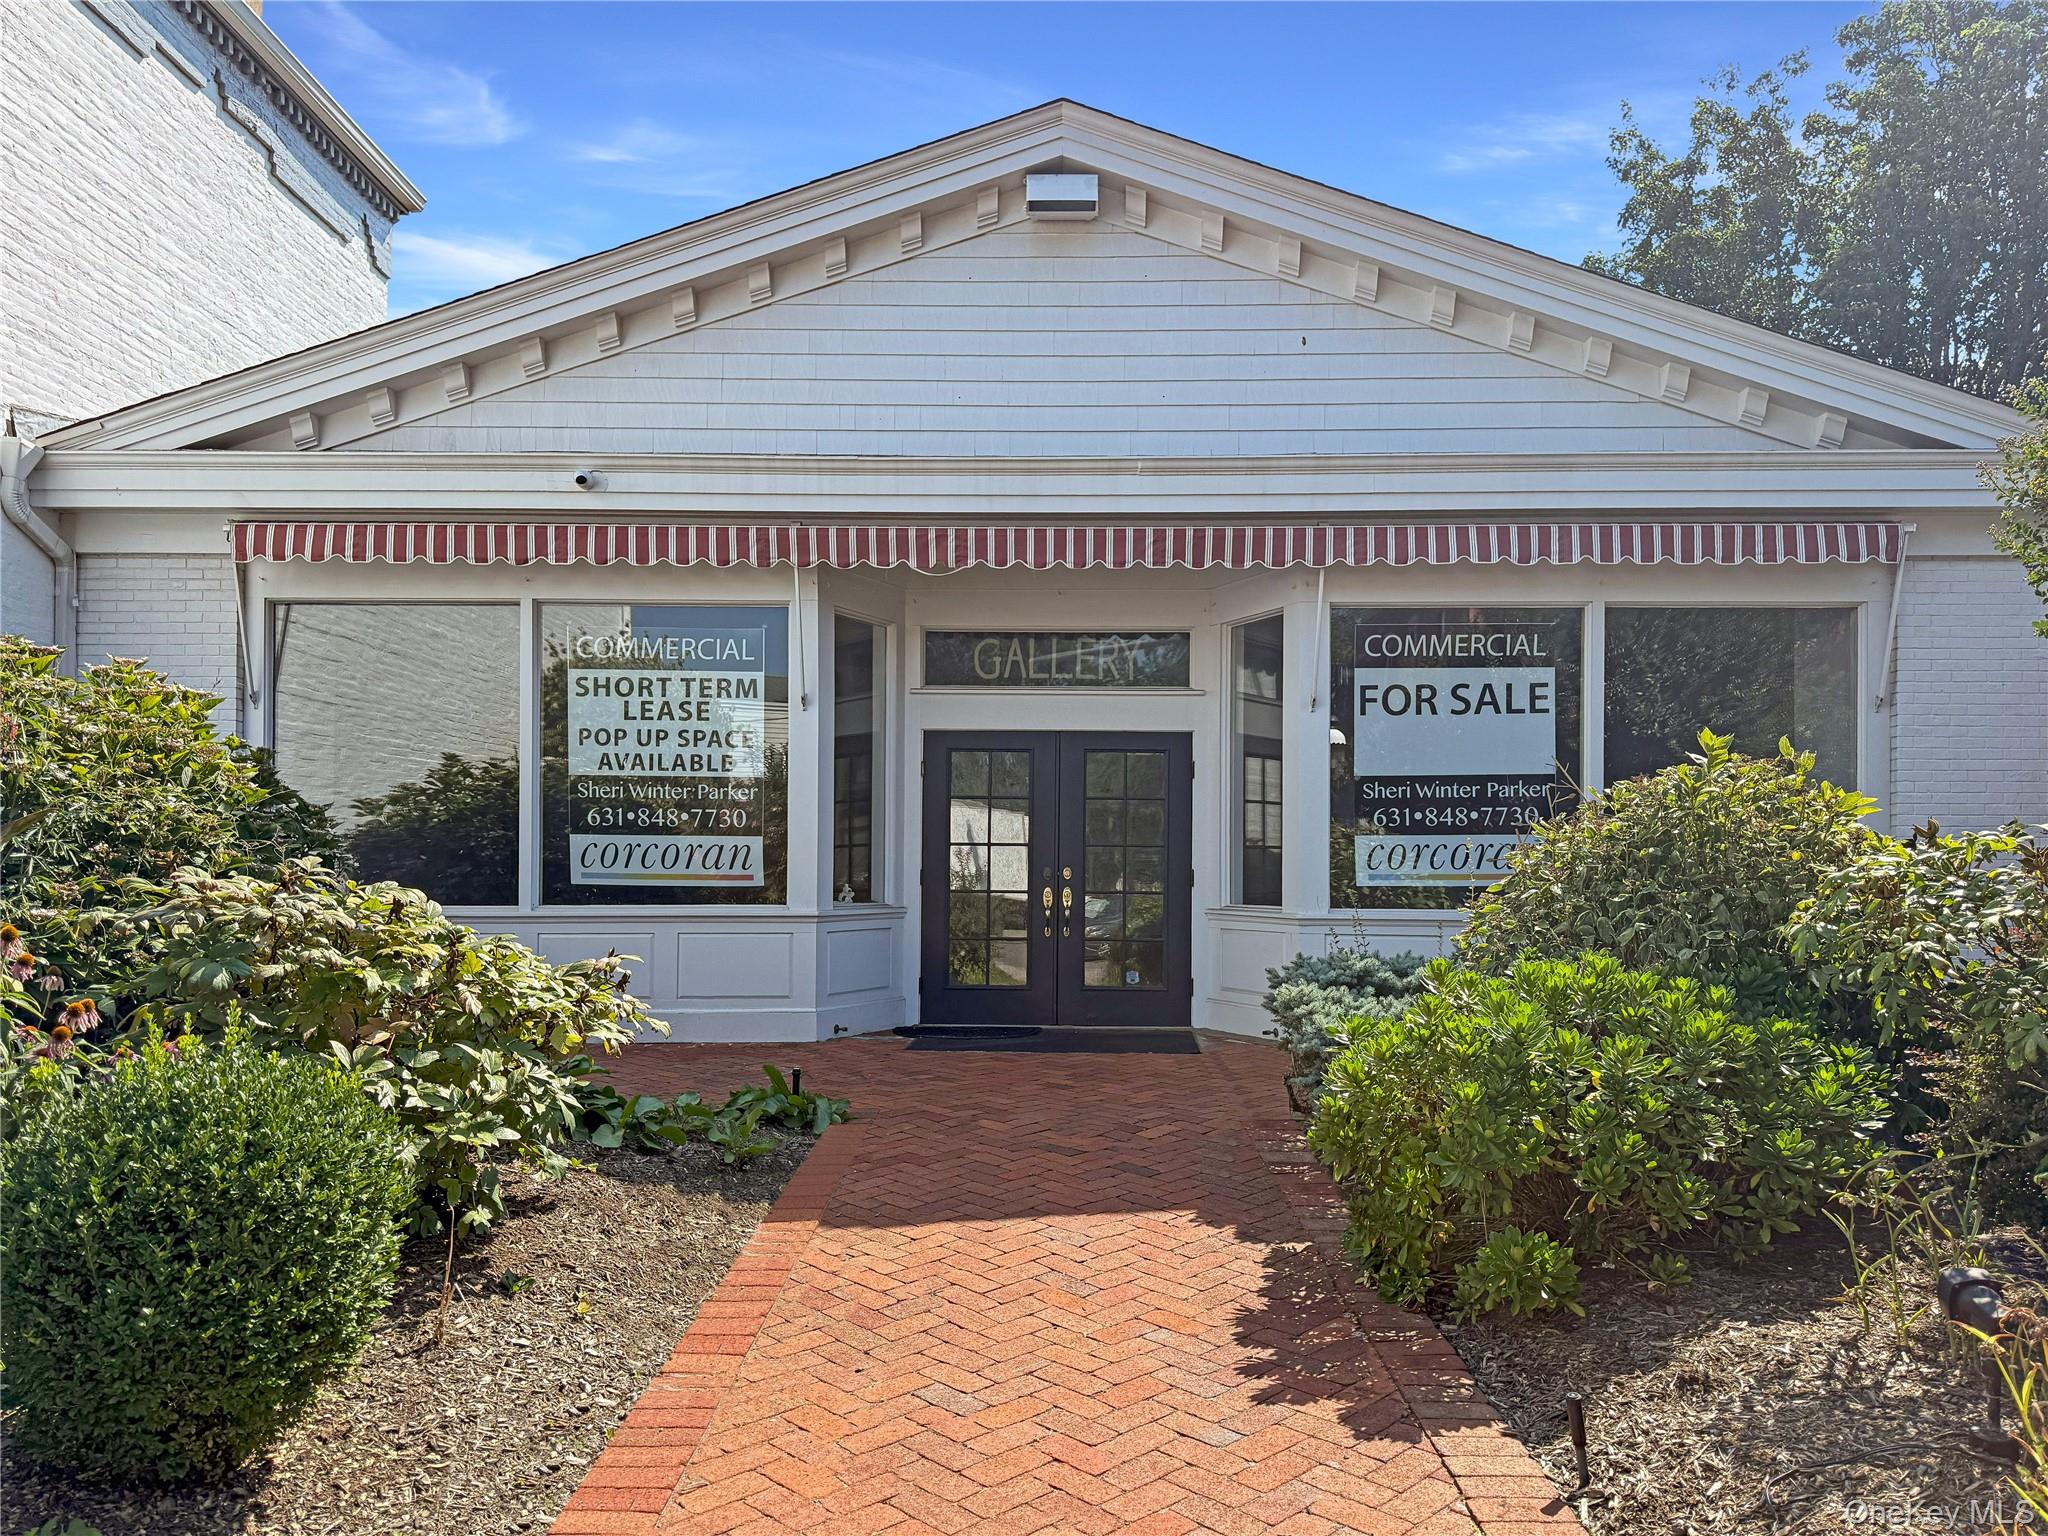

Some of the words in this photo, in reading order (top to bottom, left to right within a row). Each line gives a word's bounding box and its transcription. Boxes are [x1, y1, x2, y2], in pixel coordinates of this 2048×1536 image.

[576, 635, 755, 661] COMMERCIAL
[1364, 633, 1547, 658] COMMERCIAL
[973, 637, 1143, 681] GALLERY
[574, 676, 672, 699] SHORT
[682, 677, 759, 699] TERM
[1359, 683, 1438, 716] FOR
[1450, 682, 1550, 716] SALE
[623, 700, 710, 722] LEASE
[578, 728, 628, 747] POP
[636, 729, 670, 748] UP
[677, 730, 755, 749] SPACE
[597, 752, 734, 773] AVAILABLE
[577, 780, 624, 800] Sheri
[629, 782, 694, 801] Winter
[699, 783, 759, 801] Parker
[1362, 780, 1411, 799] Sheri
[1415, 780, 1481, 799] Winter
[1487, 779, 1549, 799] Parker
[580, 841, 753, 871] corcoran
[1366, 842, 1517, 871] corcora
